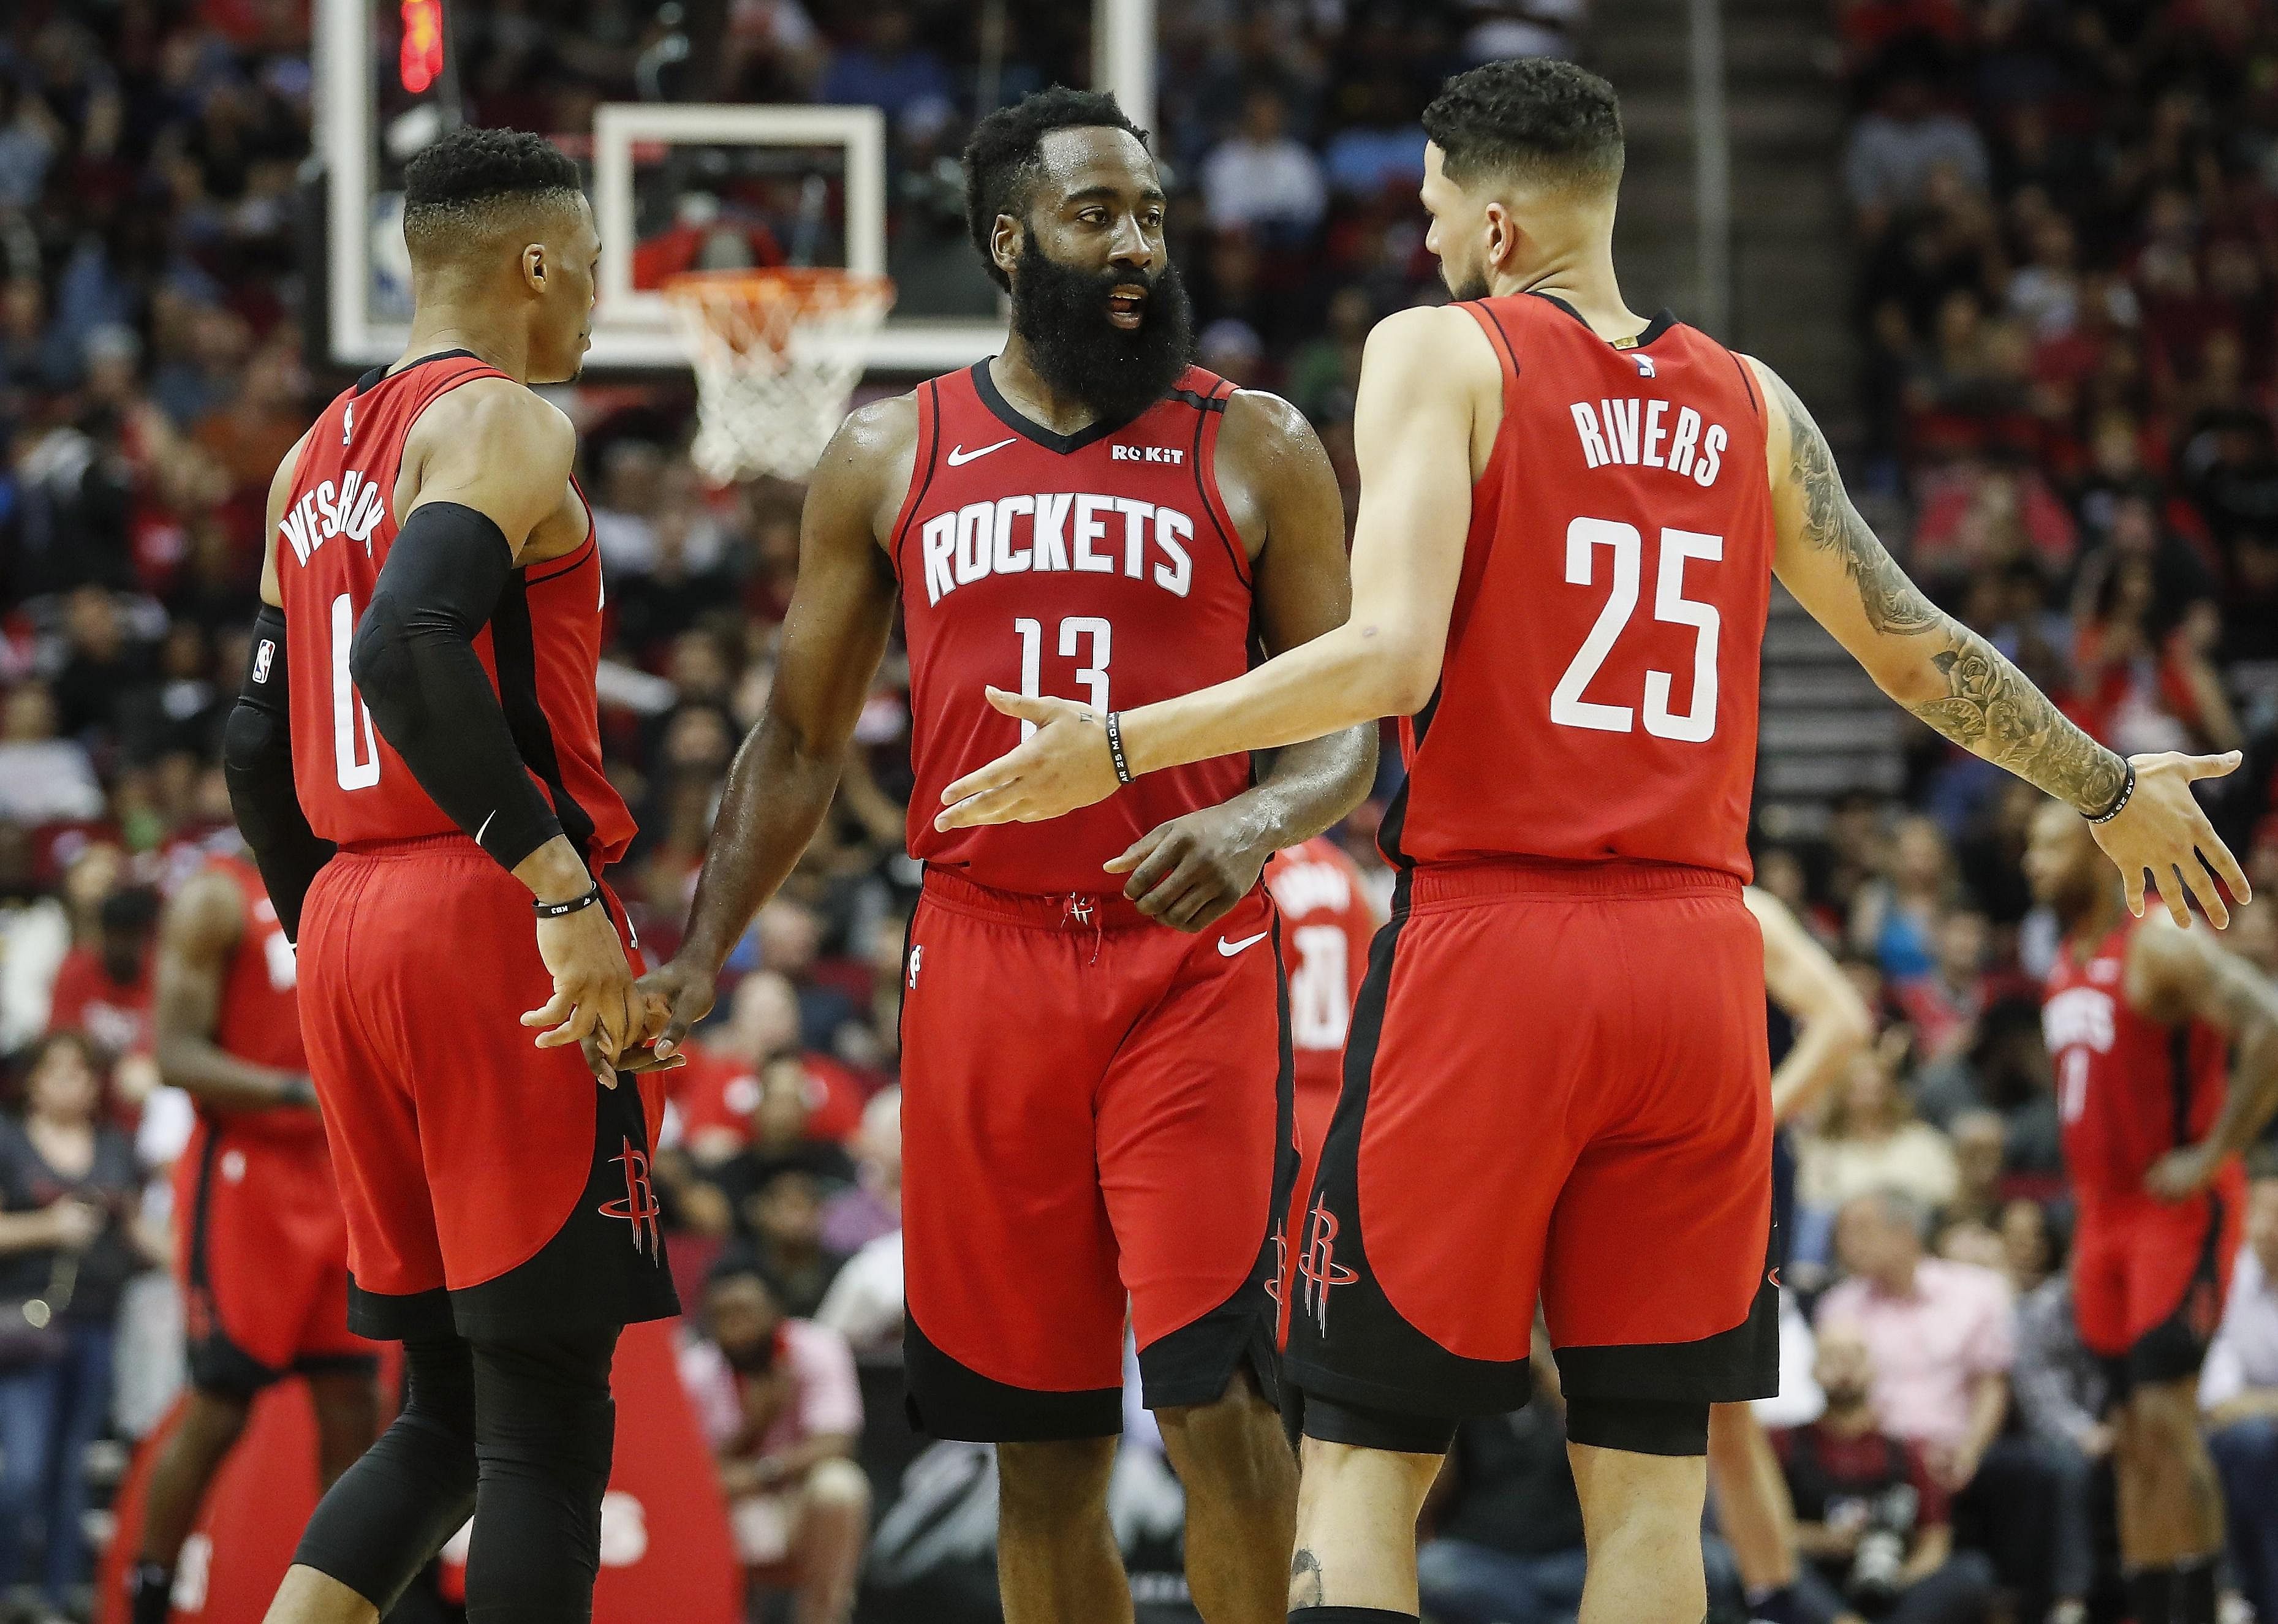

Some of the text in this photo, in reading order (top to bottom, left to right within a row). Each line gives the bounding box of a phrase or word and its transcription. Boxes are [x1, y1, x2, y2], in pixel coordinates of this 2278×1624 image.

[1569, 398, 1728, 488] RIVERS
[921, 492, 1194, 608] ROCKETS
[1015, 616, 1112, 744] 13
[1550, 516, 1724, 743] 25
[1114, 754, 1123, 768] 25
[1119, 771, 1129, 782] AR
